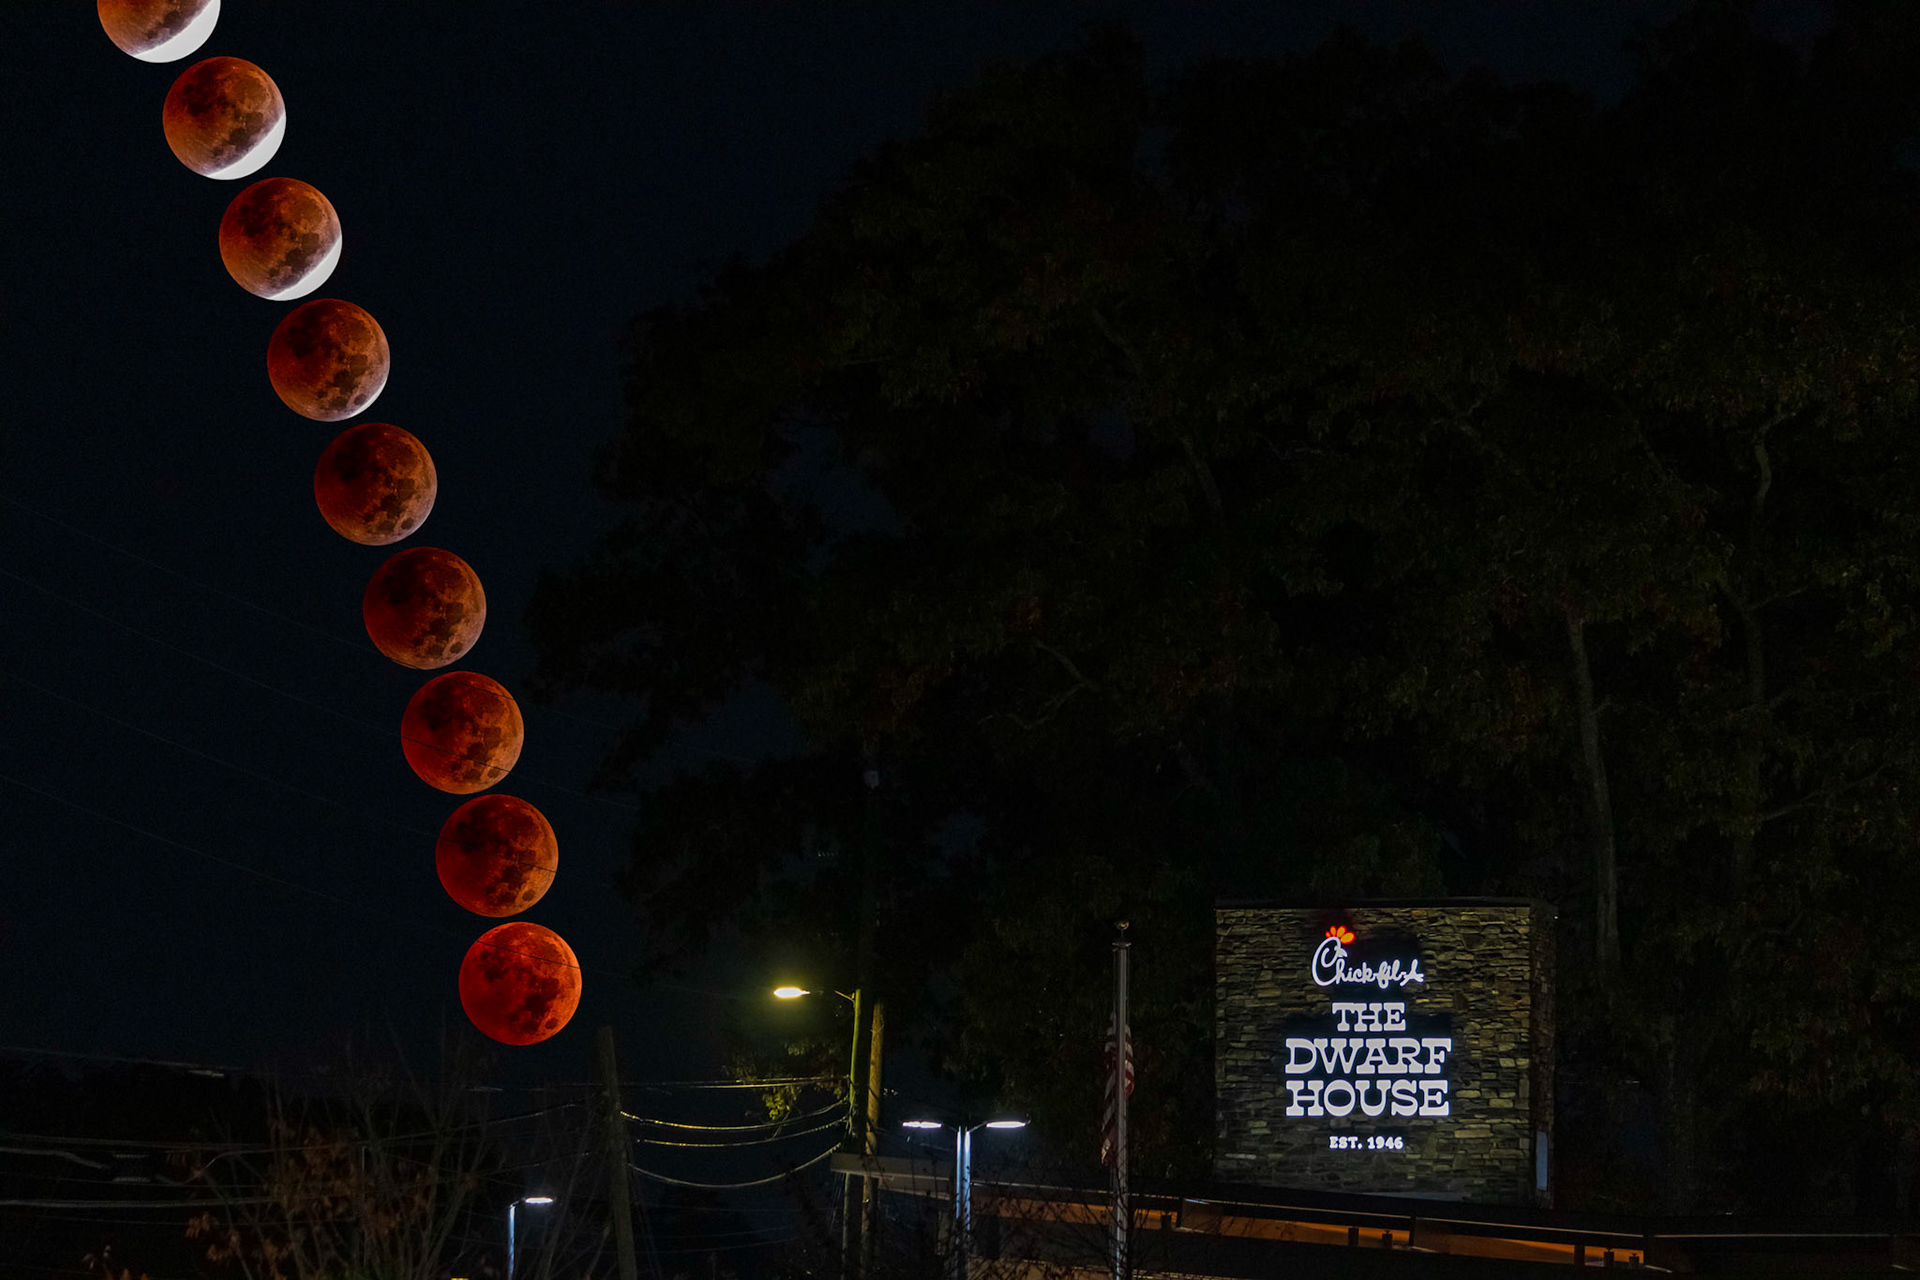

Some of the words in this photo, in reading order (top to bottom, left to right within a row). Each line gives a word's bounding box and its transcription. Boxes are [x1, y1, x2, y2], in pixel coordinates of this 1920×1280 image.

[1311, 936, 1425, 989] Chick-fil-A
[1332, 1002, 1406, 1032] THE
[1285, 1037, 1452, 1075] DWARF
[1285, 1079, 1450, 1117] HOUSE
[1329, 1136, 1363, 1150] EST.
[1367, 1136, 1404, 1150] 1946
